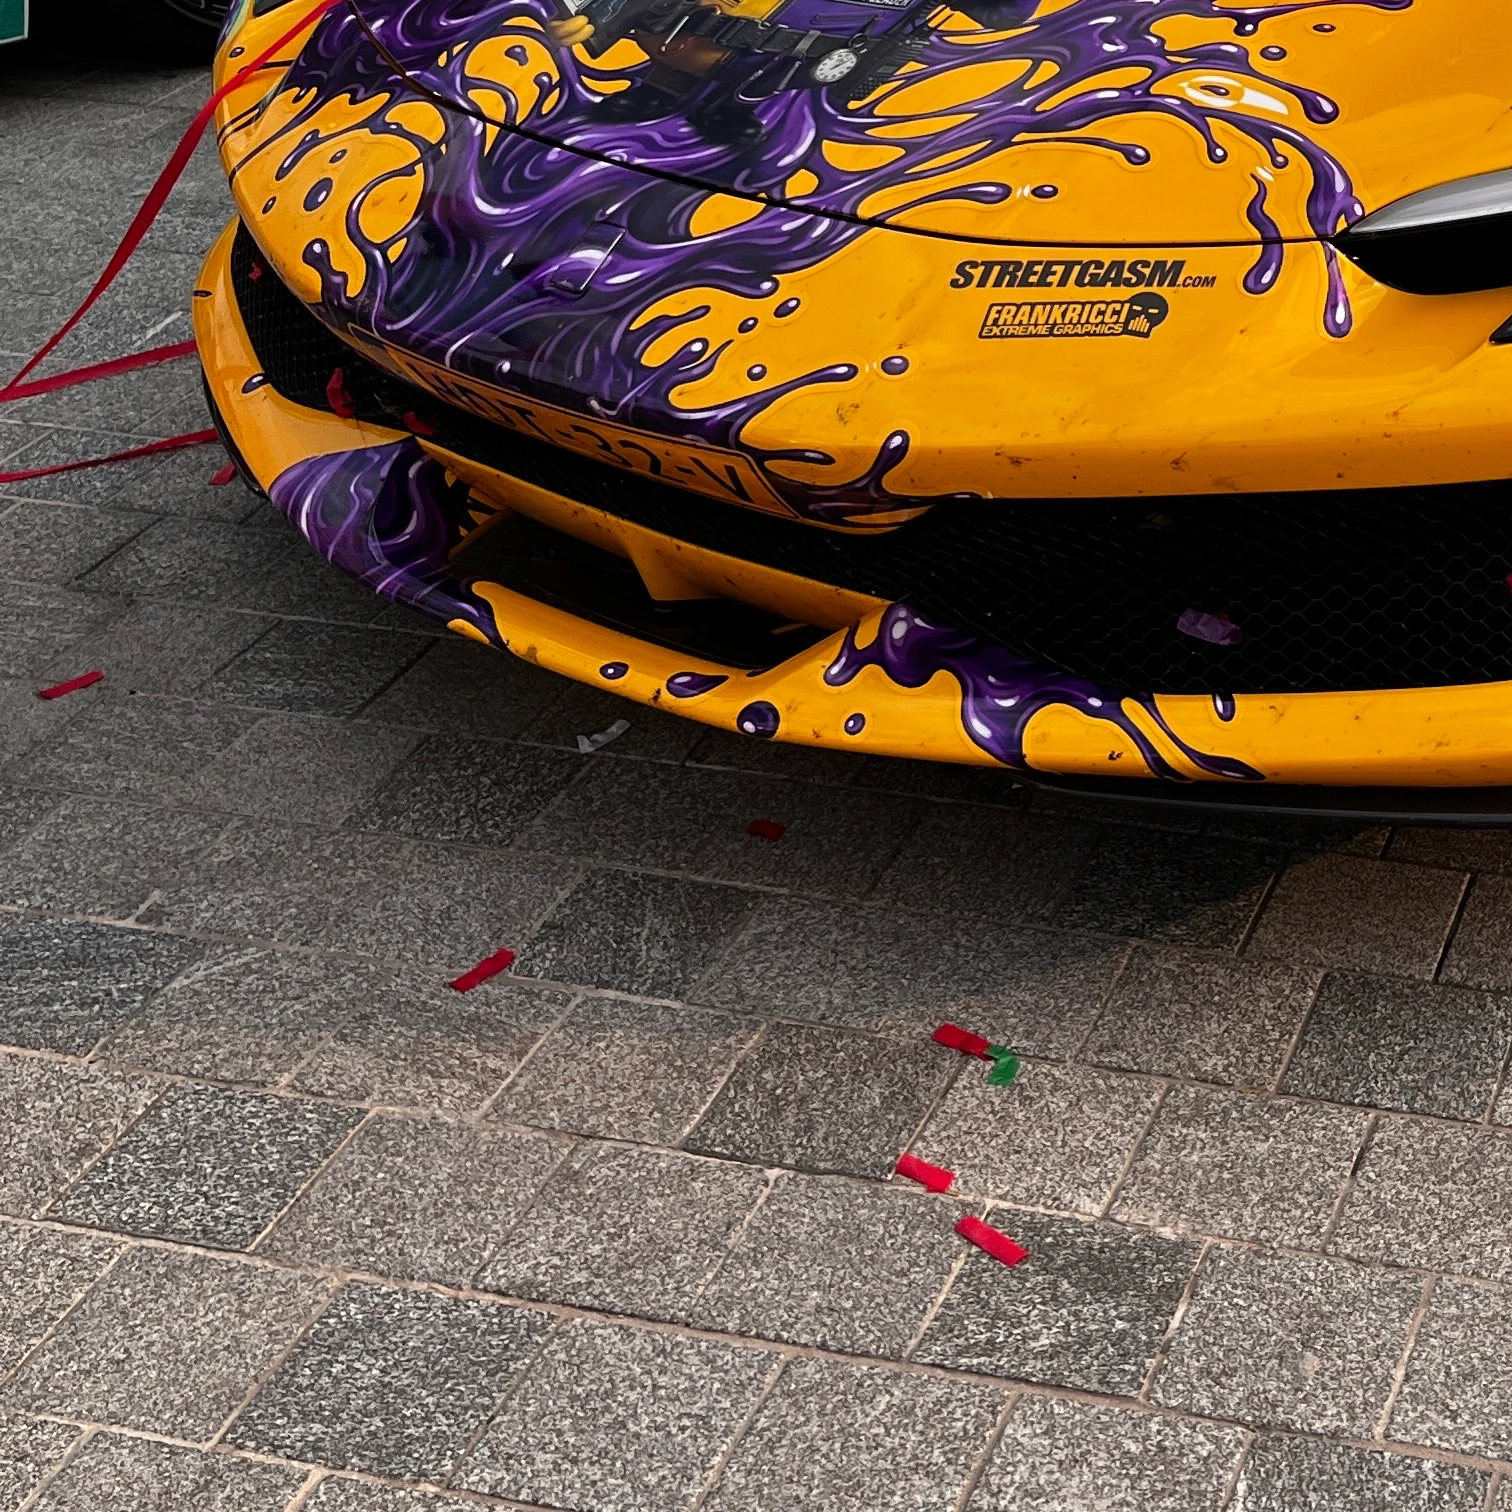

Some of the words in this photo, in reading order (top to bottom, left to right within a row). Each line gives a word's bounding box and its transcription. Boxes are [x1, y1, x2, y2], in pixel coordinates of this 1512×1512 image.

[986, 302, 1131, 326] FRANKRICCI
[981, 324, 1051, 337] EXTREME
[1053, 323, 1125, 336] GRAPHICS
